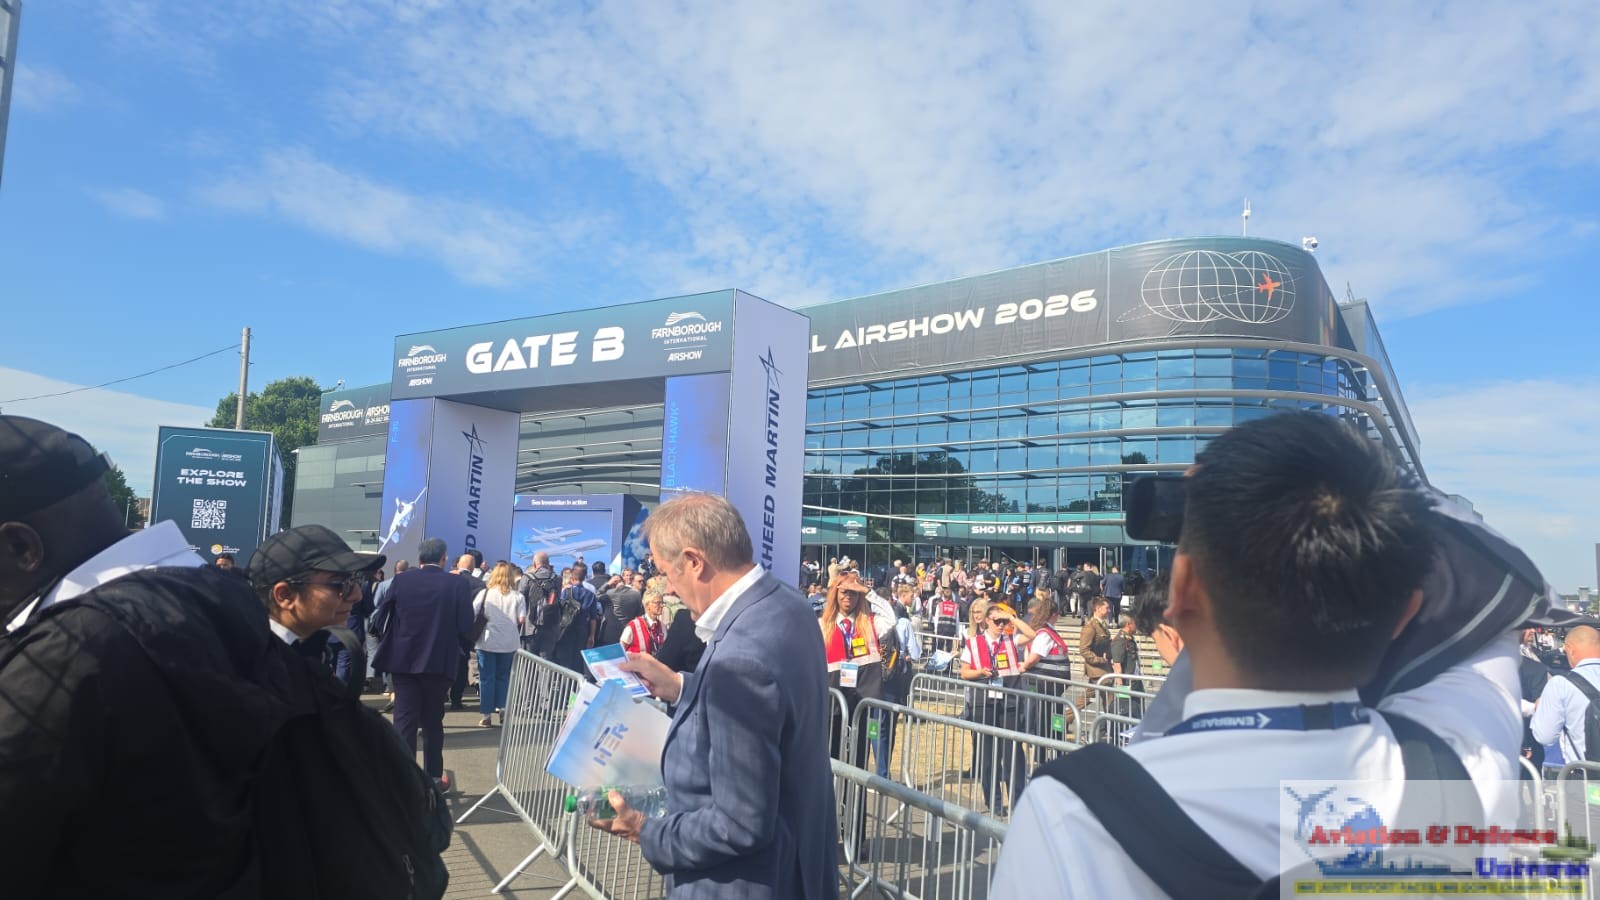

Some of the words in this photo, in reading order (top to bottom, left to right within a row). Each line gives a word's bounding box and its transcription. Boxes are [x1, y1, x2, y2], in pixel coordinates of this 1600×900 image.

[808, 334, 827, 353] L
[834, 307, 985, 350] AIRSHOW
[995, 289, 1098, 326] 2026
[652, 321, 722, 339] FARNBOROUGH
[664, 335, 708, 345] INTERNATIONAL
[466, 331, 579, 374] GATE
[592, 326, 625, 363] B
[667, 350, 703, 362] AIRSHOW
[398, 353, 447, 368] FARNBOROUGH
[321, 409, 364, 424] FARNBOROUGH
[765, 389, 780, 489] MARTIN
[180, 468, 245, 479] EXPLORE
[666, 447, 677, 487] BLACK
[176, 476, 203, 485] THE
[206, 478, 247, 487] SHOW
[467, 454, 484, 529] MARTIN
[971, 525, 1009, 534] SHOW
